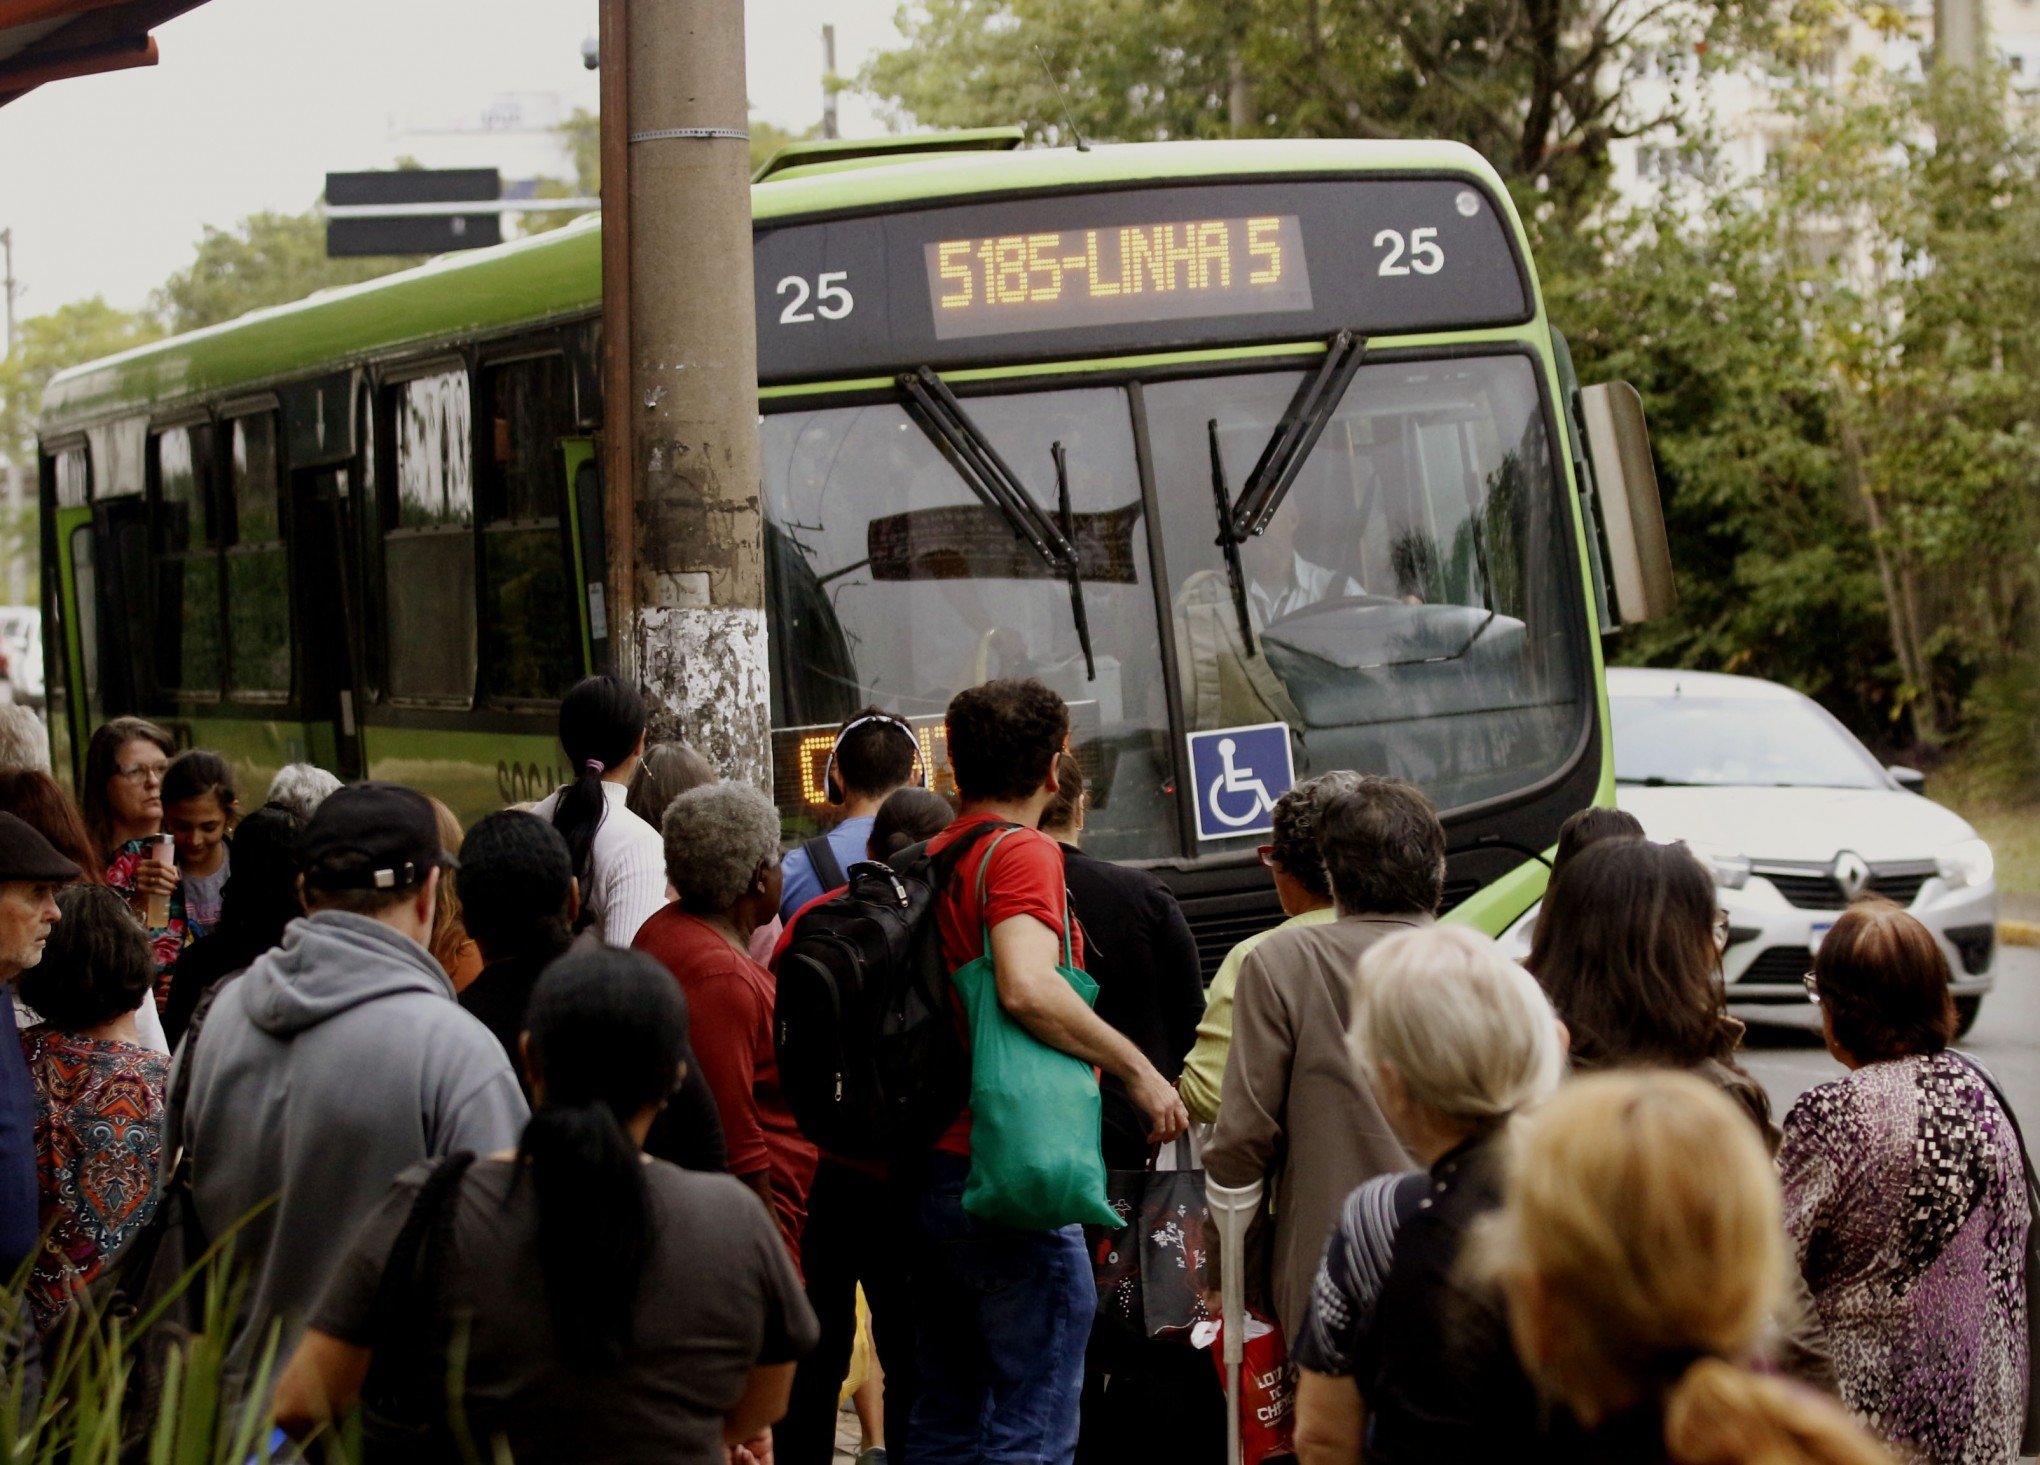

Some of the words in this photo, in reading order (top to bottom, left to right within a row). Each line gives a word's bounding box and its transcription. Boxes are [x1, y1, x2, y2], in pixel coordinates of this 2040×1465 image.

[1247, 218, 1281, 285] 5
[1374, 226, 1445, 277] 25
[776, 270, 854, 324] 25
